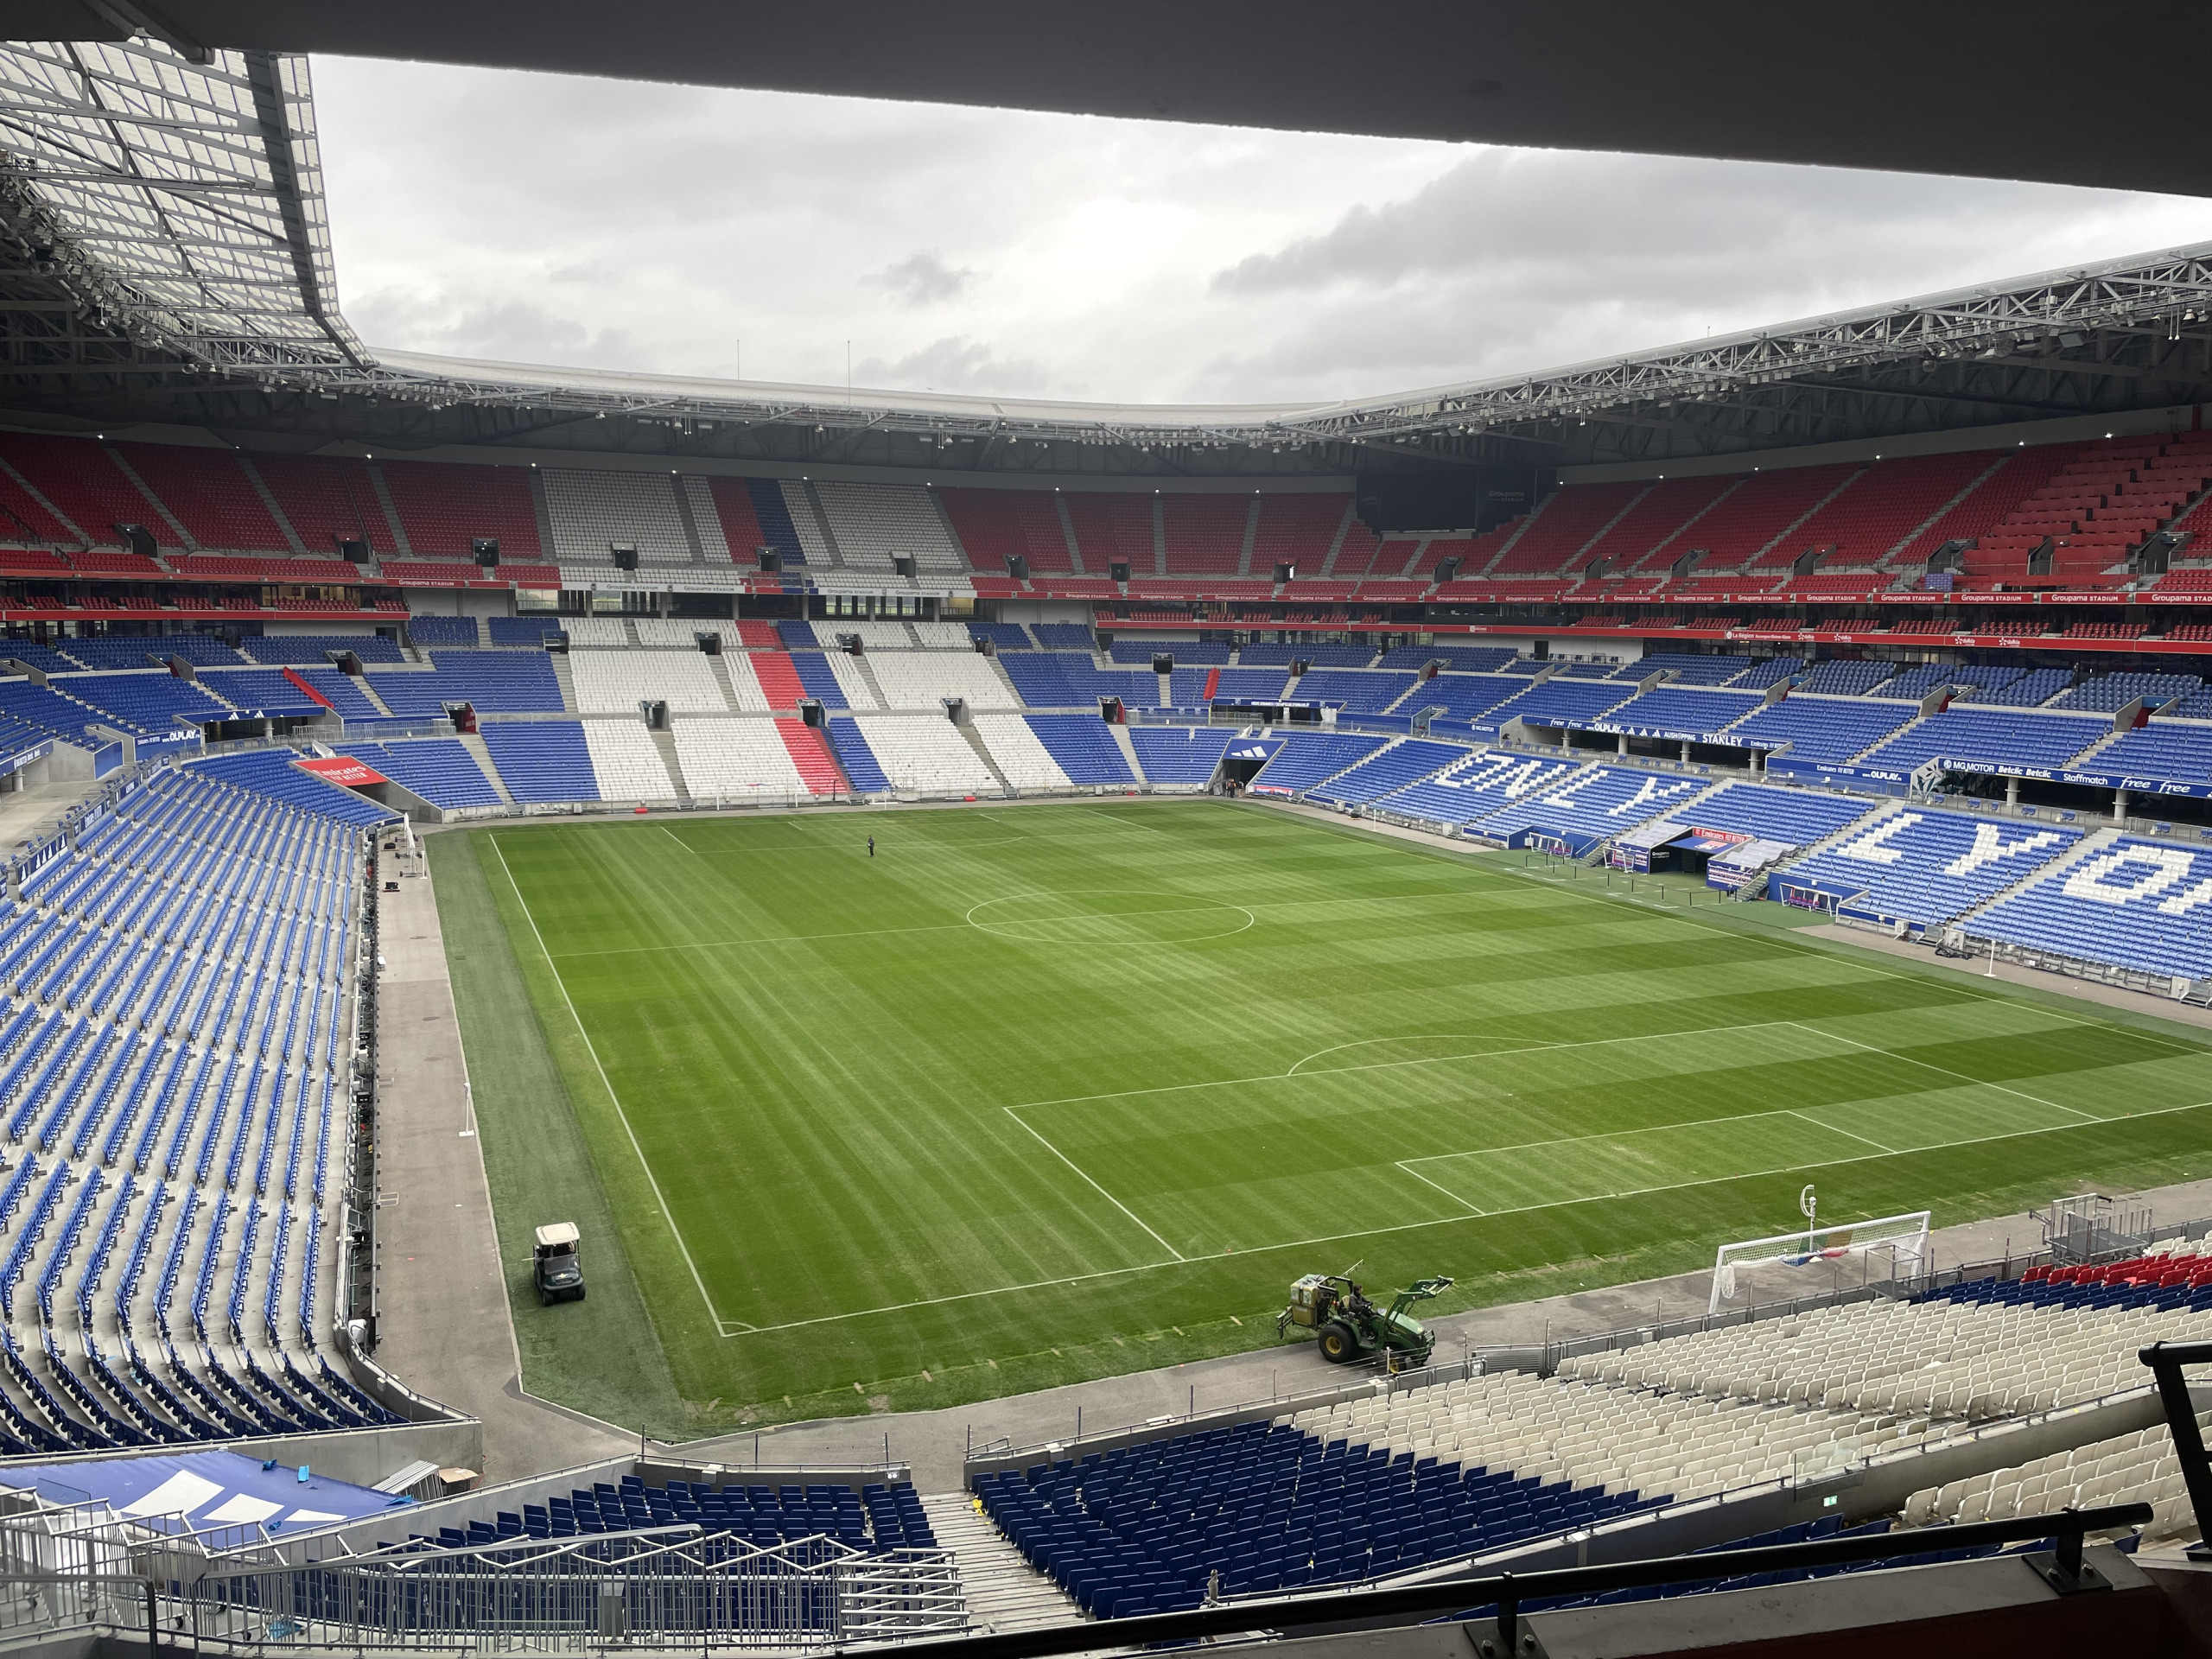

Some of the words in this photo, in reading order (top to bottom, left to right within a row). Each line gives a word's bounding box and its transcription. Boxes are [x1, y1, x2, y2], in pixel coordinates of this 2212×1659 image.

[1489, 490, 1524, 499] Groupama
[2051, 594, 2088, 602] Groupama
[2152, 594, 2192, 603] Groupama
[1550, 718, 1565, 727] free
[1567, 719, 1582, 728] free
[1702, 734, 1743, 747] STANLEY
[1953, 761, 1966, 770] MG
[1967, 763, 1994, 773] MOTOR
[1999, 766, 2023, 775] Betclic
[2025, 768, 2051, 779] Betclic
[2063, 772, 2108, 785] Staffmatch
[2120, 777, 2151, 789] free
[2158, 781, 2191, 793] free
[1701, 830, 1724, 840] Emirates
